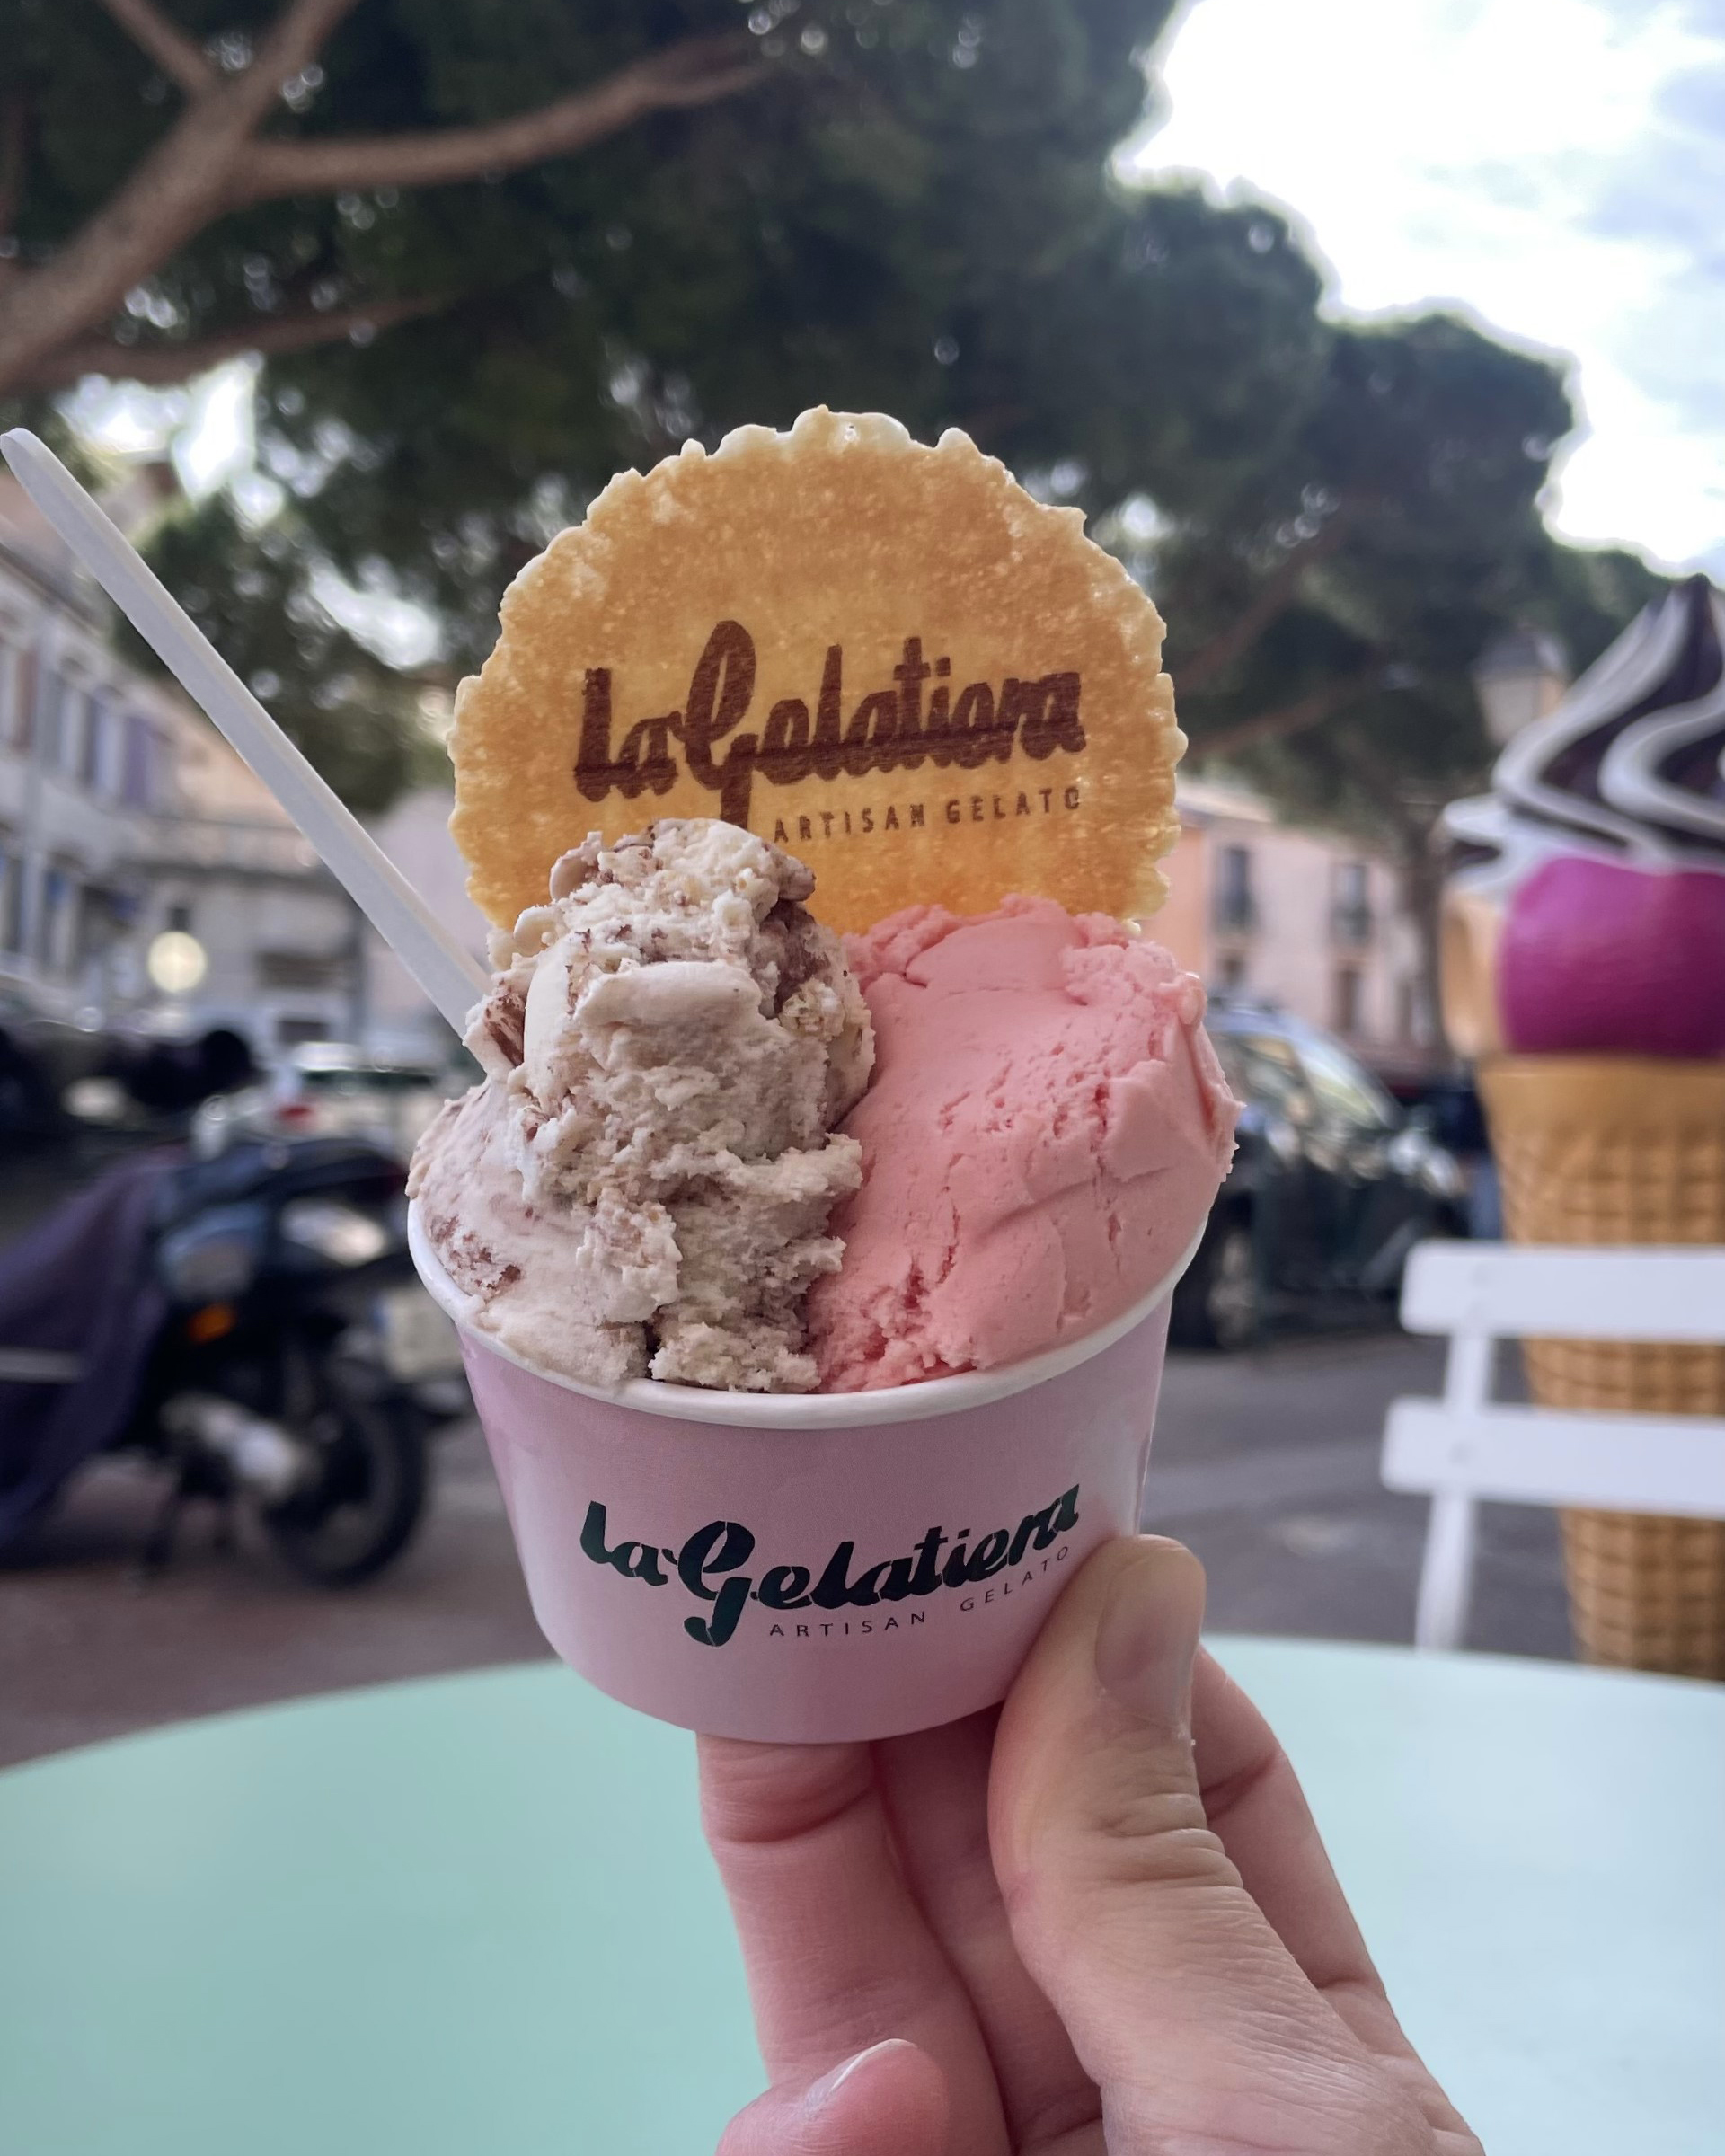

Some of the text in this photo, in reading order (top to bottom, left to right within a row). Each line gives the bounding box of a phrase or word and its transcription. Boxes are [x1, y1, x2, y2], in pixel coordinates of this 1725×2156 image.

[573, 667, 680, 802] La
[773, 786, 1080, 844] ARTISAN GELATO
[579, 1483, 1080, 1647] La Gelatiera
[769, 1545, 1069, 1638] ARTISAN GELATO
